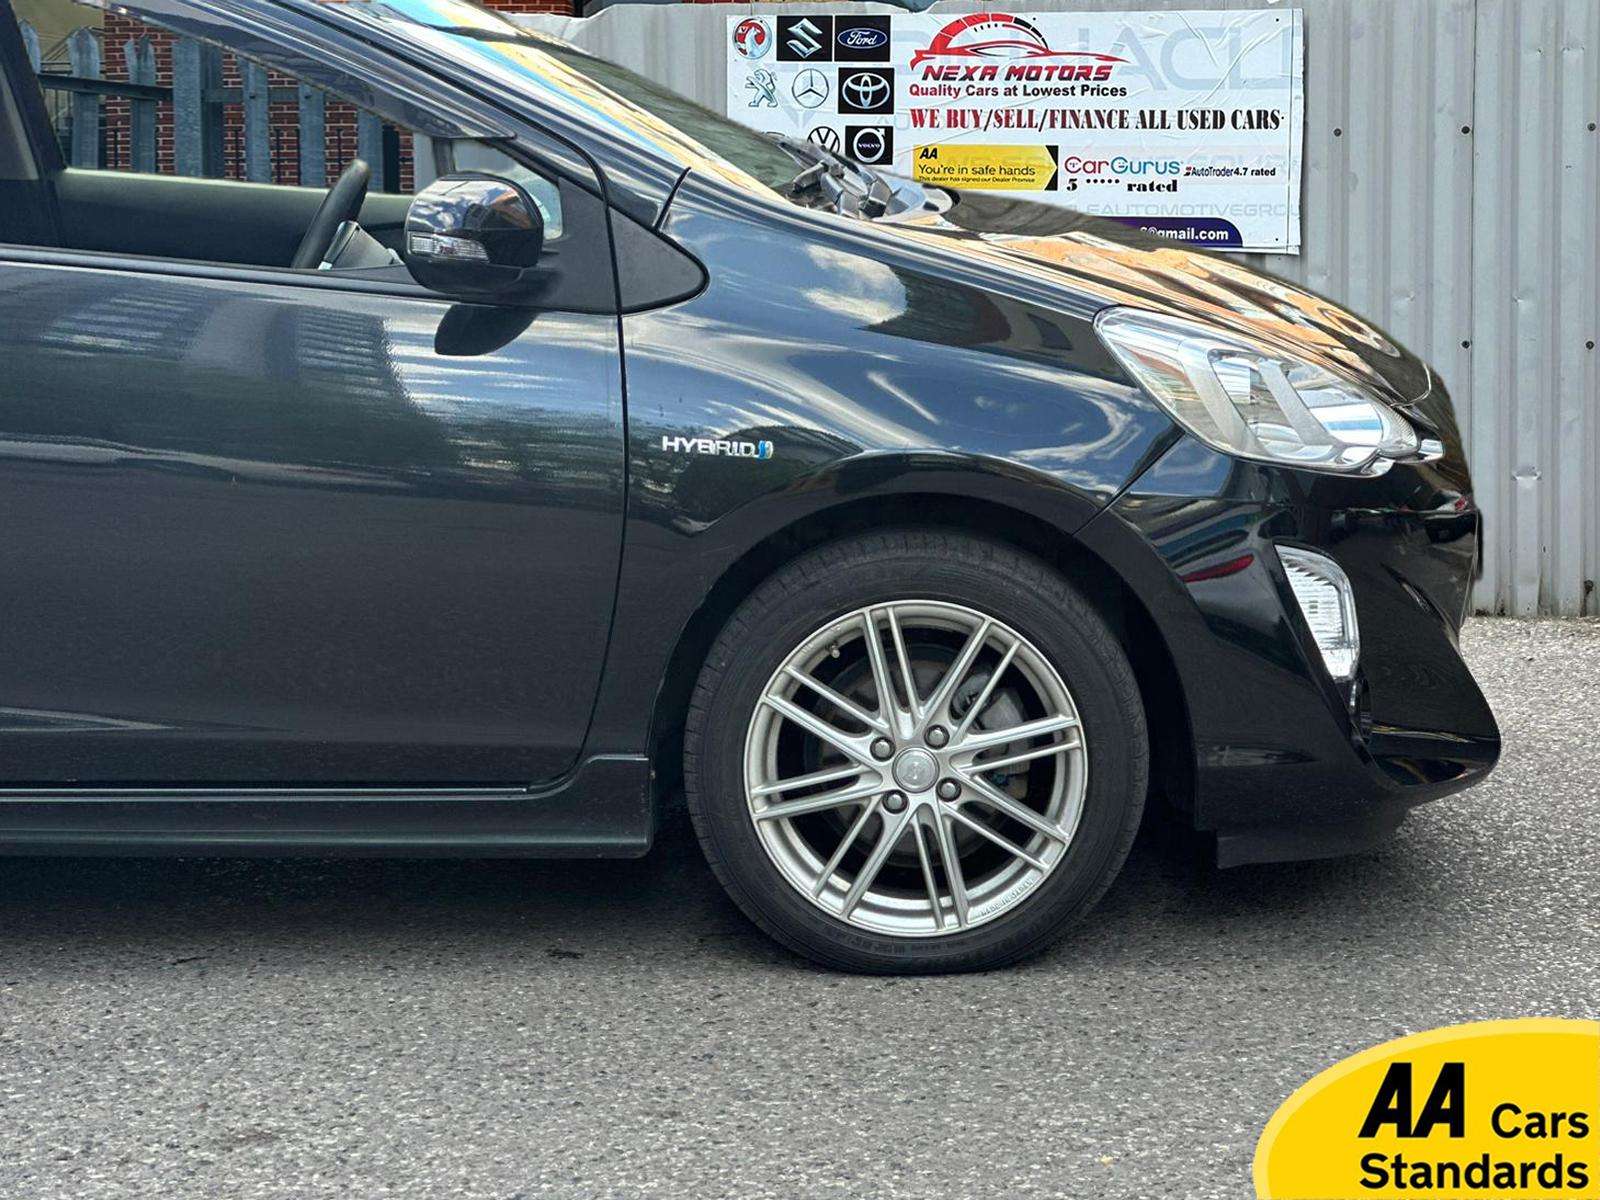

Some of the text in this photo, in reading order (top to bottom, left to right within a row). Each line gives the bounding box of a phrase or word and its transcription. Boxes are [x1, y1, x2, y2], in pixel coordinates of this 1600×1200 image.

[847, 31, 878, 45] Ford
[921, 65, 1113, 81] NEXA MOTORS
[909, 84, 1127, 99] Quality Cars at Lowest Prices
[909, 108, 940, 129] WE
[946, 108, 1130, 132] BUY/SELL/FINANCE
[1135, 109, 1171, 130] ALL
[1177, 109, 1226, 130] USED
[920, 148, 938, 159] AA
[919, 163, 1036, 176] You're in safe hands
[1064, 156, 1181, 175] CarGurus
[1250, 167, 1276, 177] rated
[1066, 178, 1178, 193] 5 rated
[662, 435, 756, 458] HYBRID
